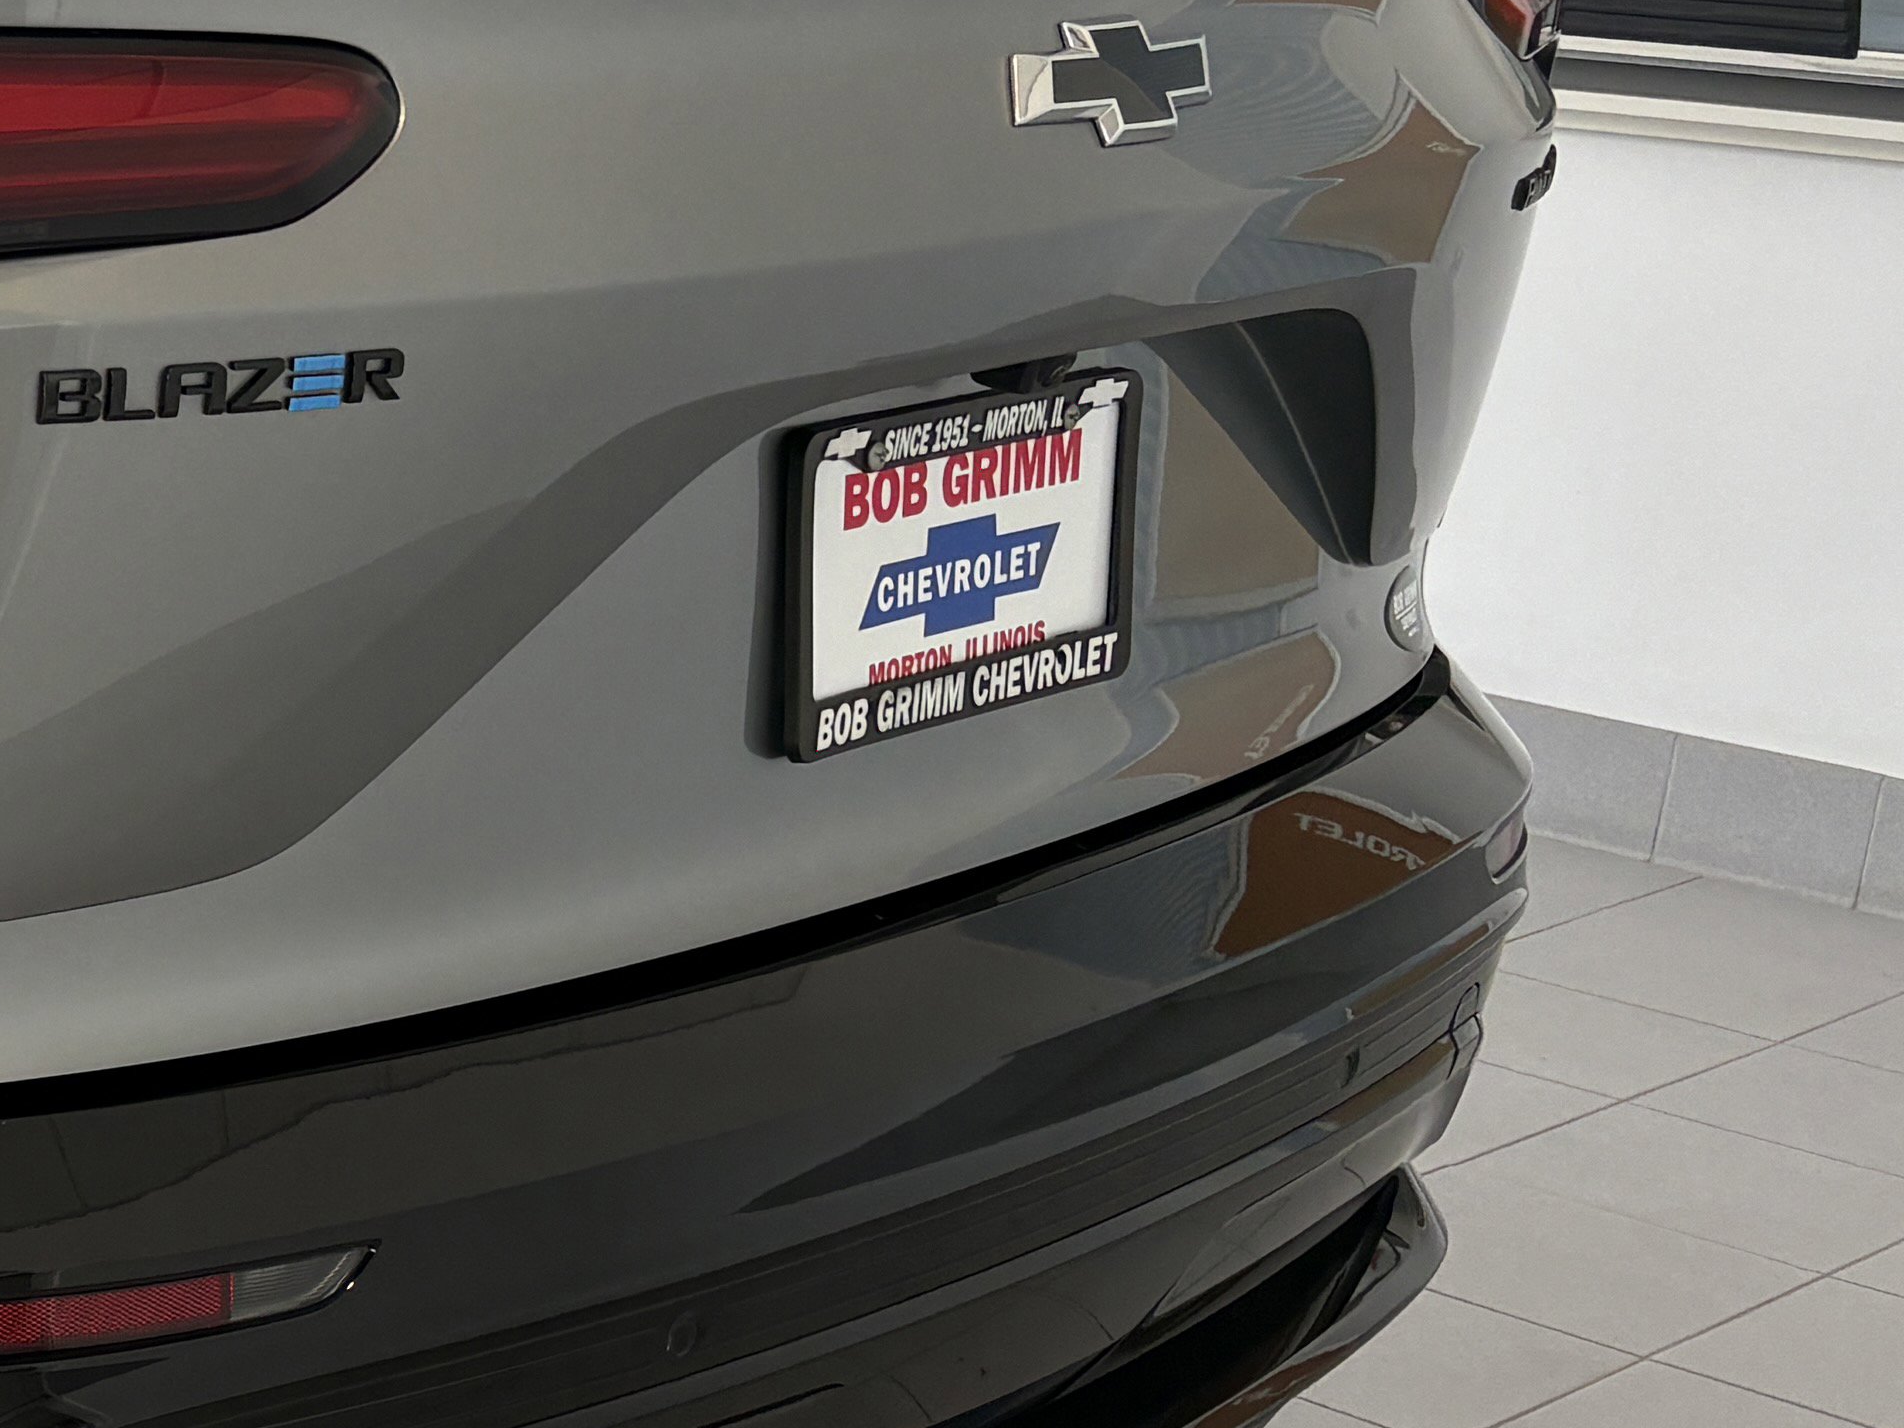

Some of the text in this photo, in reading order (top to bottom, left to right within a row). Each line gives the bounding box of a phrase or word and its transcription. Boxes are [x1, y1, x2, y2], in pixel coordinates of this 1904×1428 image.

[36, 347, 405, 425] BLAZER
[885, 422, 933, 463] SINCE
[931, 413, 971, 453] 1951
[982, 399, 1048, 443] MORTON,
[1051, 396, 1065, 428] IL
[843, 428, 1082, 531] BOB GRIMM
[877, 541, 1041, 613] CHEVROLET
[965, 620, 1046, 661] ILLINOIS
[816, 632, 1119, 752] BOB GRIMM CHEVROLET
